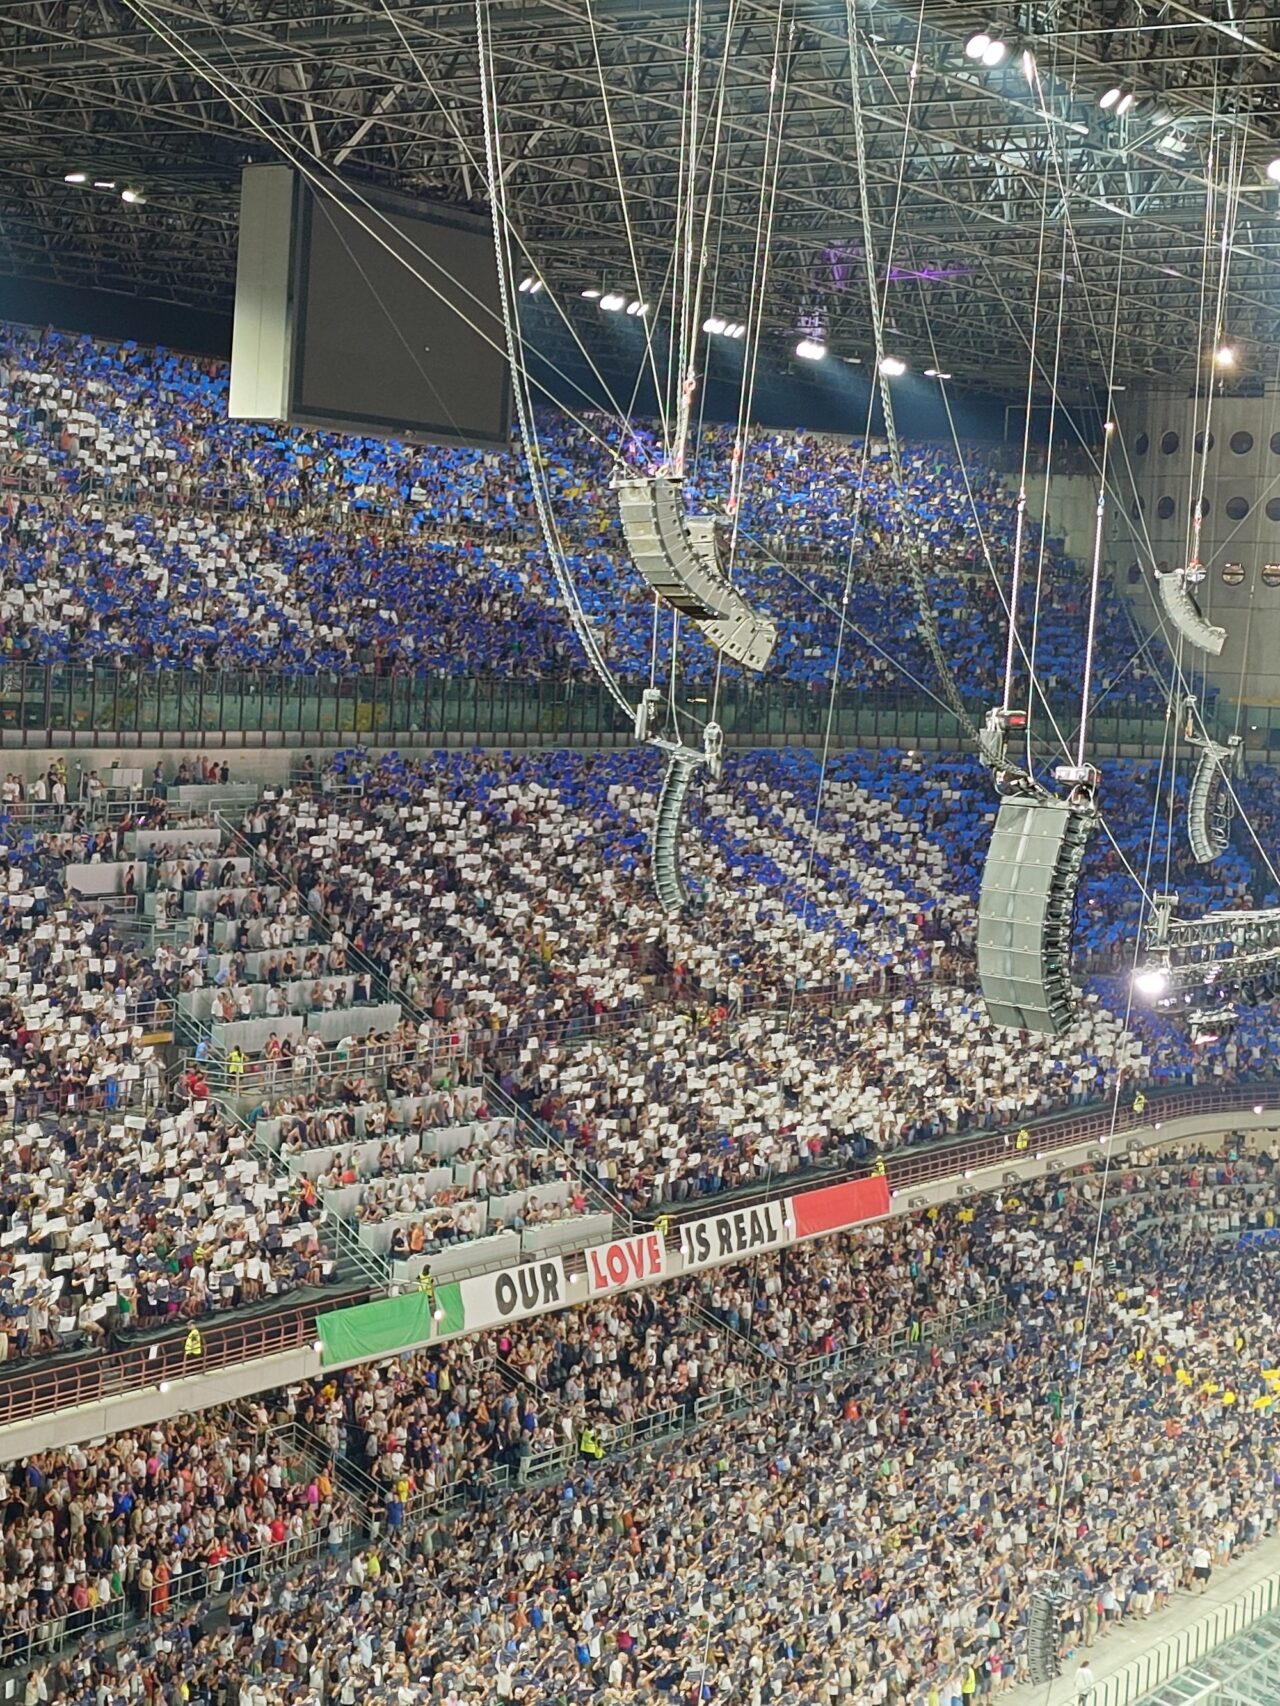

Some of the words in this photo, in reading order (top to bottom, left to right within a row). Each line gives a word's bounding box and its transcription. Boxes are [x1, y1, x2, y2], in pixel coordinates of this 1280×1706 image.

[495, 1262, 560, 1315] OUR
[591, 1235, 661, 1289] LOVE
[685, 1223, 711, 1264] IS
